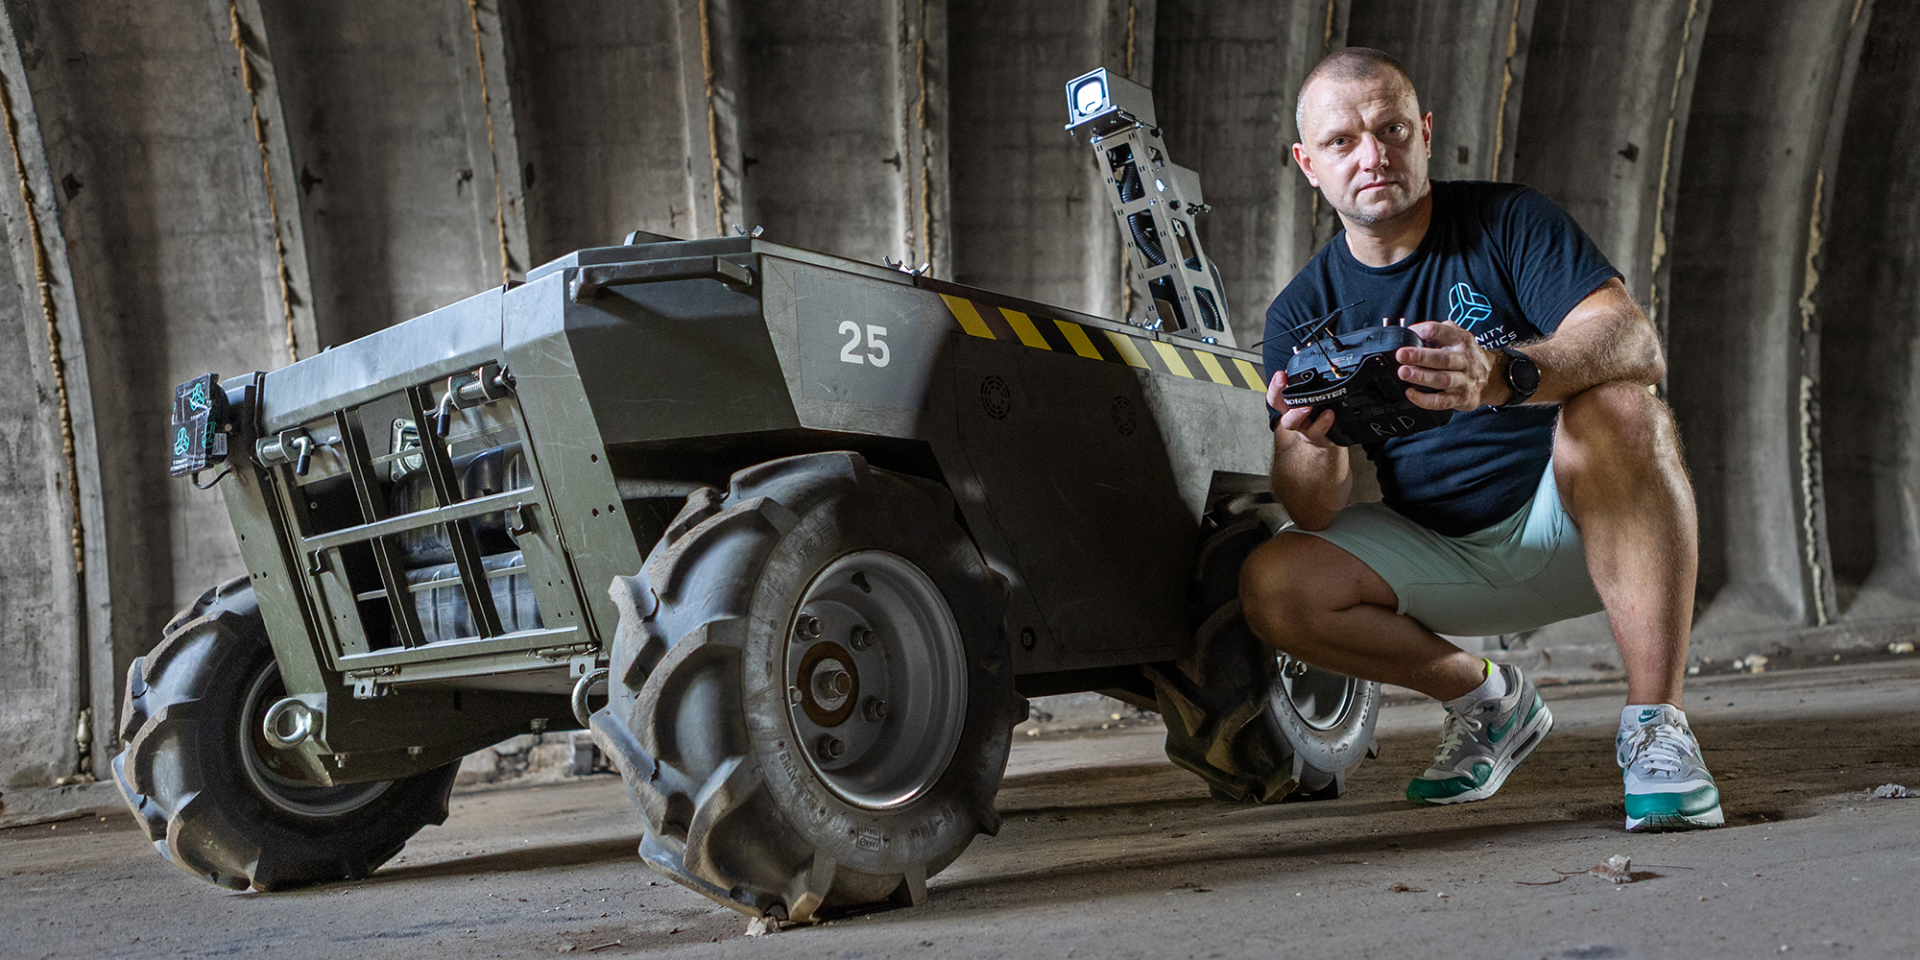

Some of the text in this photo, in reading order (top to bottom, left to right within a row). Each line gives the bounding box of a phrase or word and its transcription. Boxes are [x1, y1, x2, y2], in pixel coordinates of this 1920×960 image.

[838, 320, 891, 368] 25
[1474, 324, 1505, 344] NITY
[1480, 330, 1517, 351] OTICS
